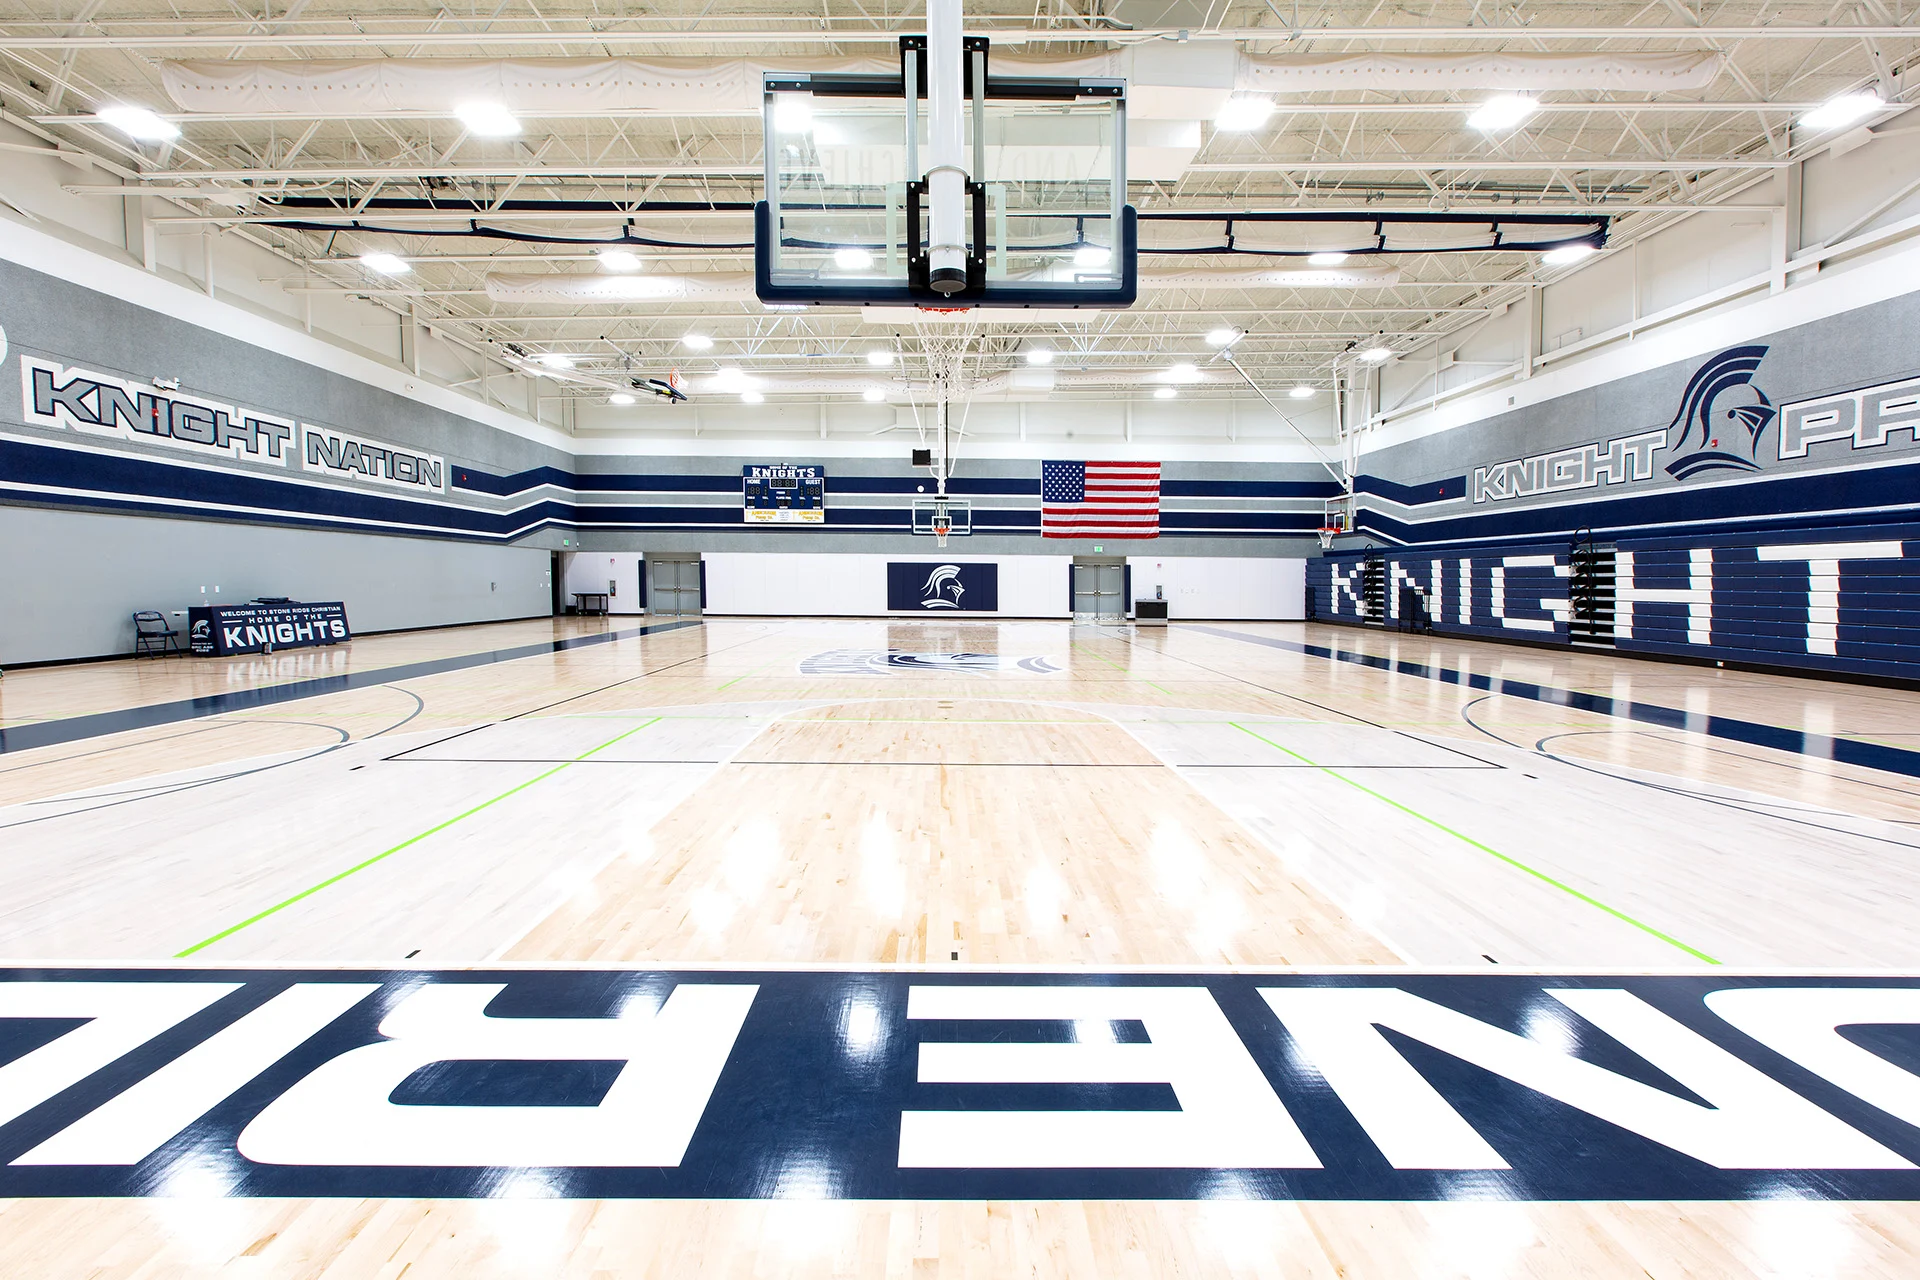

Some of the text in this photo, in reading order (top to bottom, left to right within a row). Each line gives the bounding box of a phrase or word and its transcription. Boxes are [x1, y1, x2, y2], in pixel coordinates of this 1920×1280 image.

[21, 356, 445, 494] KNIGHT NATION
[752, 467, 815, 478] KNIGHTS
[1473, 428, 1669, 503] KNIGHT
[269, 608, 291, 616] STONE
[292, 606, 310, 614] RIDGE
[311, 605, 341, 613] CHRISTIAN
[1330, 540, 1902, 656] KNIGHT
[223, 619, 346, 648] KNIGHTS
[248, 615, 279, 624] HOME
